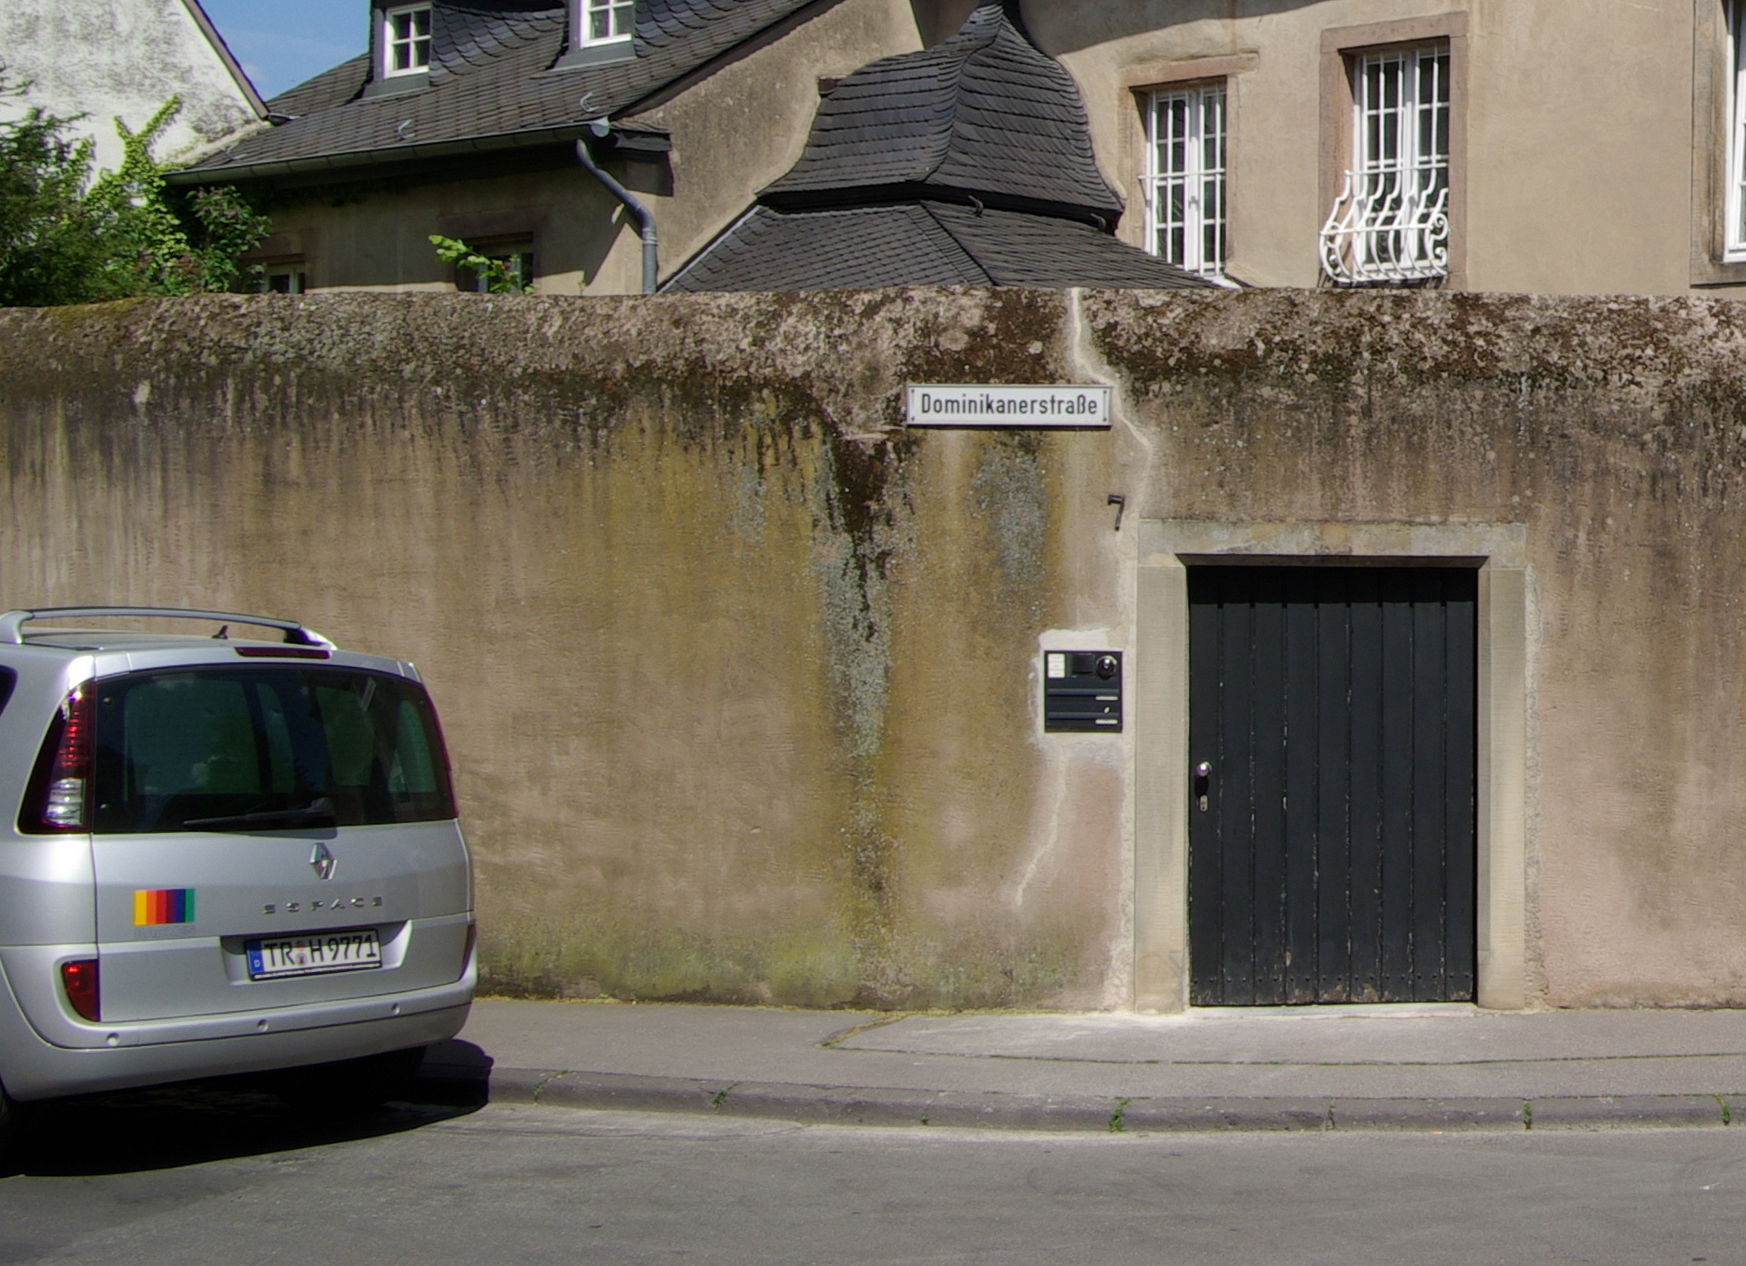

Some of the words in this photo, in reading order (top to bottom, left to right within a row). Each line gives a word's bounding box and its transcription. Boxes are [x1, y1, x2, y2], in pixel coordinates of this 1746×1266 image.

[921, 393, 1098, 415] Dominikanerstraße
[263, 896, 382, 915] ESPACE
[264, 941, 295, 967] TR
[309, 938, 324, 963] H
[327, 934, 377, 962] 9771
